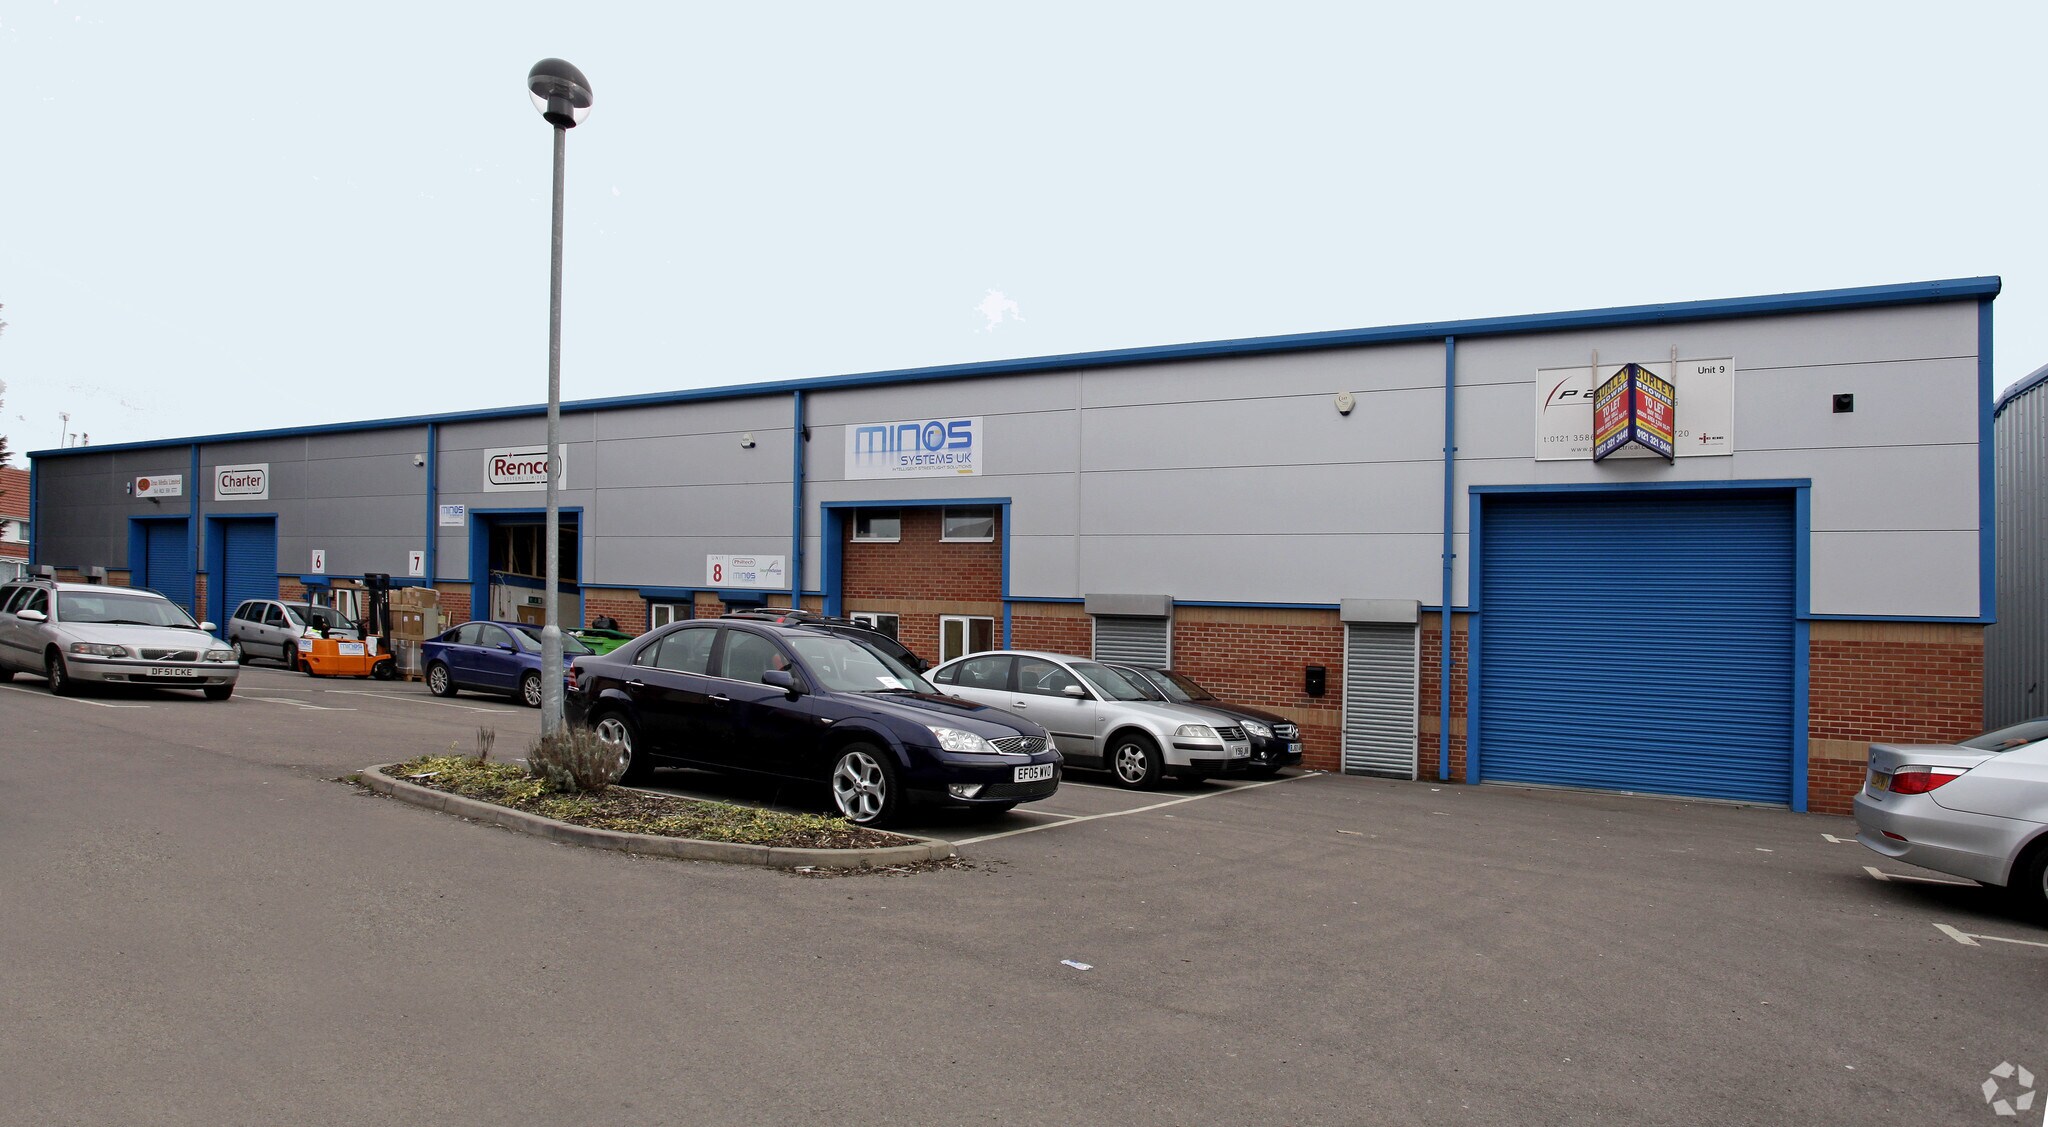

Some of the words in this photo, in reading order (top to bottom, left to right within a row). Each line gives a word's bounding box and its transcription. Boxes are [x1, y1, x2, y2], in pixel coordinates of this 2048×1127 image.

[1698, 366, 1716, 374] Unit
[1596, 368, 1629, 402] BURLEY
[1636, 368, 1674, 398] BURLEY
[1596, 381, 1628, 409] BROWNE
[1636, 381, 1672, 406] BROWNE
[1603, 406, 1610, 417] TO
[1610, 397, 1621, 413] LET
[1644, 395, 1652, 409] TO
[1653, 401, 1665, 415] LET
[1636, 428, 1648, 442] 0121
[1649, 433, 1659, 447] 321
[901, 453, 954, 466] SYSTEMS
[956, 452, 973, 463] UK
[221, 474, 262, 488] Charter
[315, 555, 322, 569] 6
[414, 556, 420, 571] 7
[713, 563, 722, 582] 8
[151, 667, 173, 676] DF51
[174, 668, 193, 676] CKE
[1018, 767, 1039, 780] EF05
